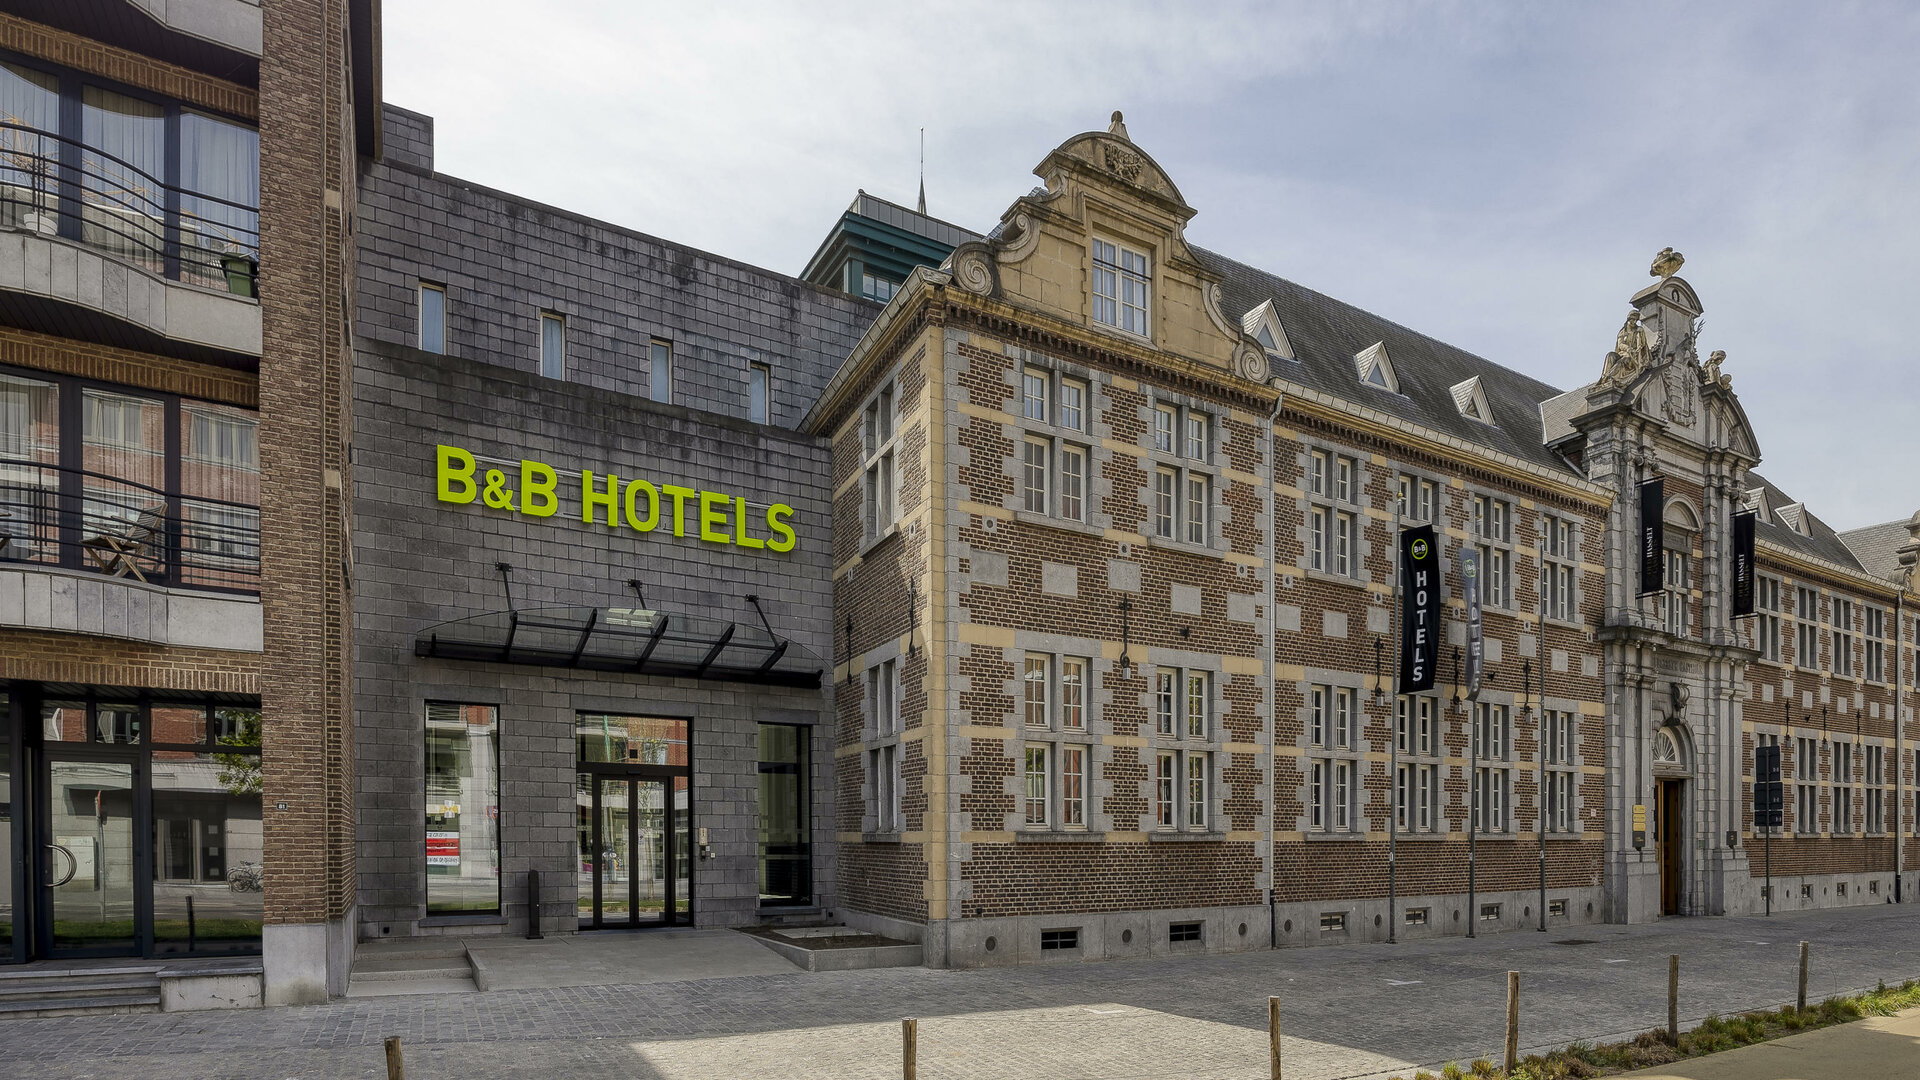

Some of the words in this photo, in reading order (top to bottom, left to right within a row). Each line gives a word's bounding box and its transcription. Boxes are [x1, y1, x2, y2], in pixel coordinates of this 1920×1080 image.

[436, 444, 558, 518] B&B
[582, 469, 797, 553] HOTELS
[1412, 570, 1427, 682] HOTELS
